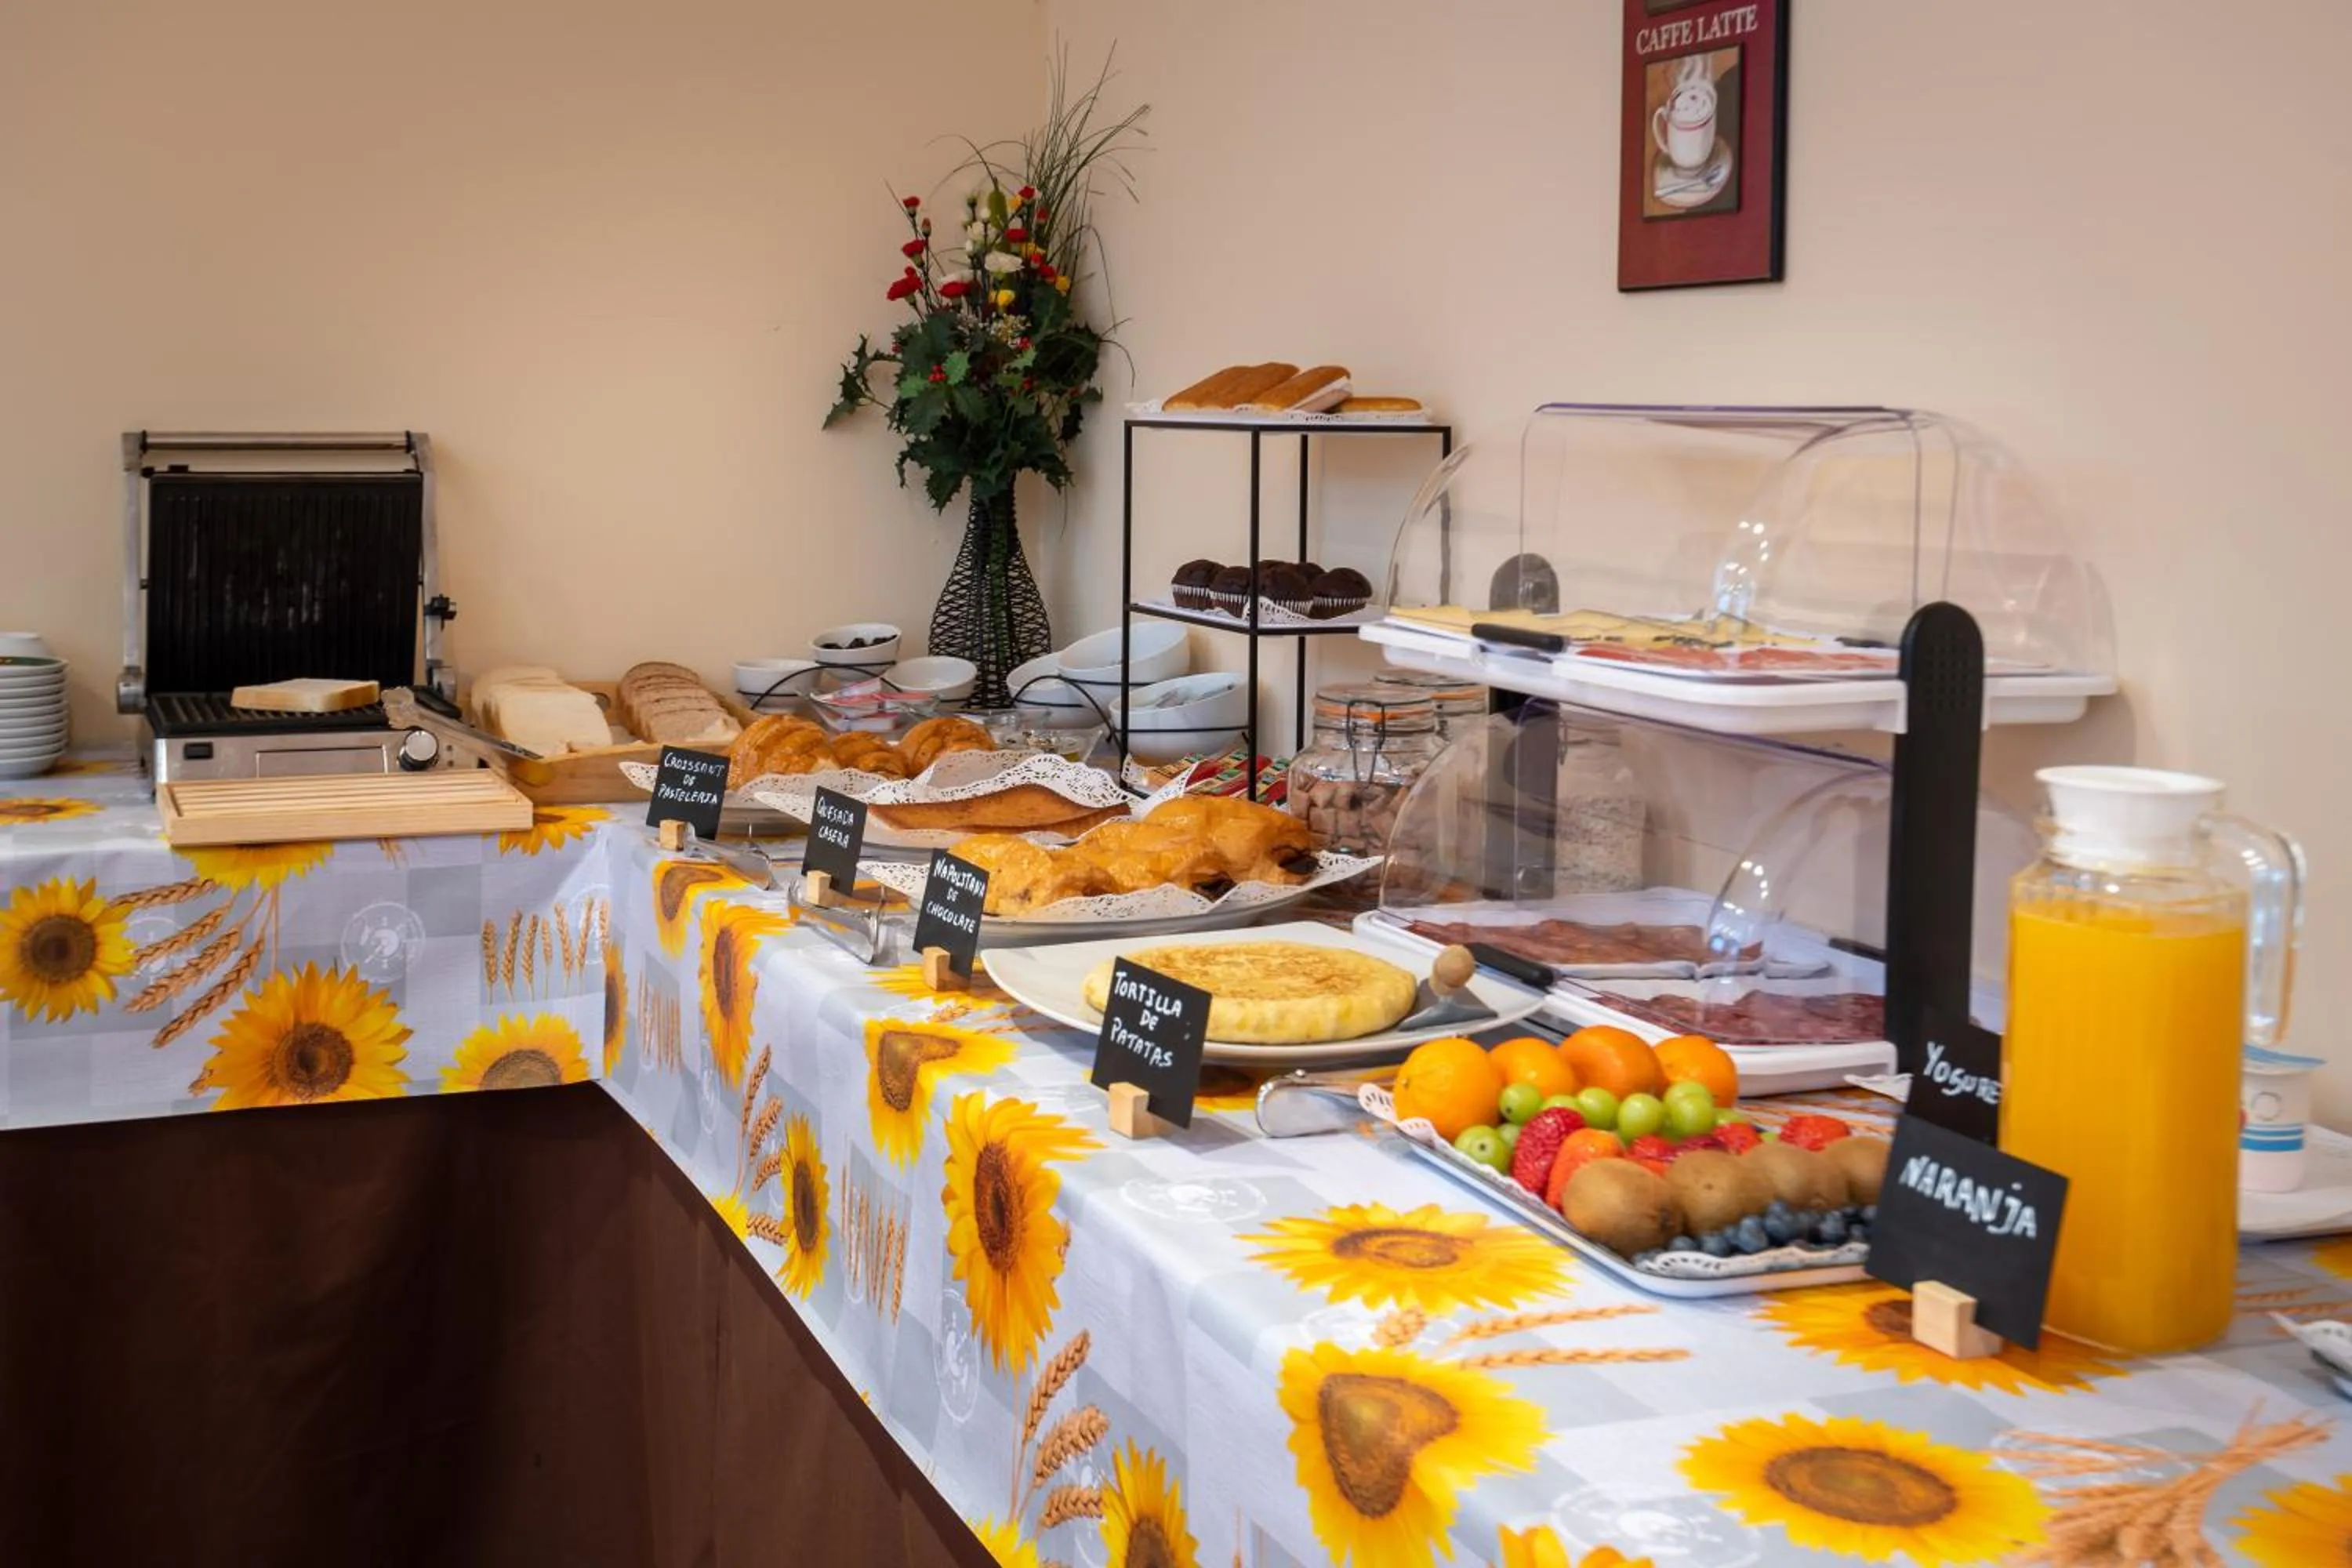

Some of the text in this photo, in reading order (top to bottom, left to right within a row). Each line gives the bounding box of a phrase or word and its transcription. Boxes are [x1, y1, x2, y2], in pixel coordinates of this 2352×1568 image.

[1635, 5, 1758, 55] CAFFE LATTE
[658, 783, 718, 804] PASTELERIA
[818, 826, 850, 849] CASERA
[933, 858, 985, 898] NAPOLITANA
[946, 887, 959, 902] DE
[925, 901, 977, 934] CHOCOLATE
[1114, 971, 1182, 1018] TORTILLA
[1139, 1009, 1160, 1031] DE
[1110, 1017, 1174, 1067] PATATAS
[1898, 1155, 2038, 1240] NARANJA
